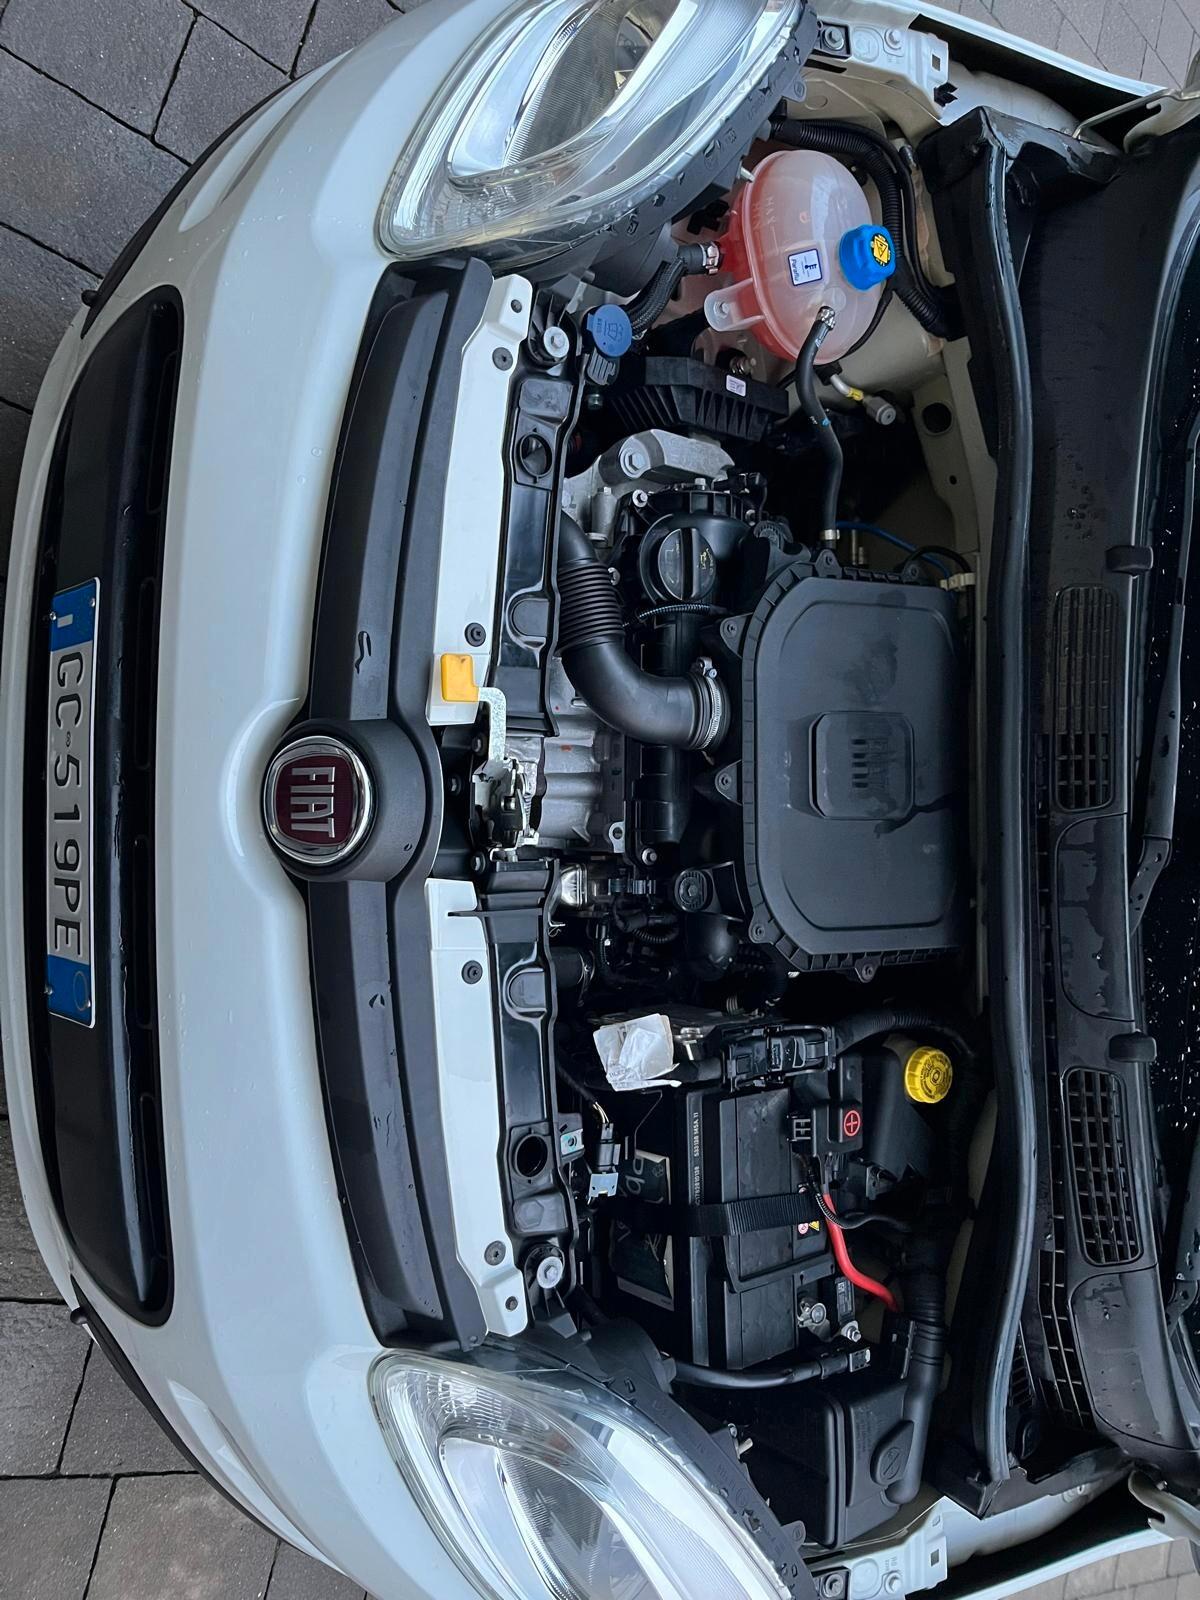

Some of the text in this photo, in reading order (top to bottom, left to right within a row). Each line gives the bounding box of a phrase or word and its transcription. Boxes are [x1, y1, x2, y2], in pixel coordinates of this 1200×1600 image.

[791, 258, 800, 282] Paraflu
[52, 652, 84, 957] GC 519PE
[289, 766, 336, 838] FIAT
